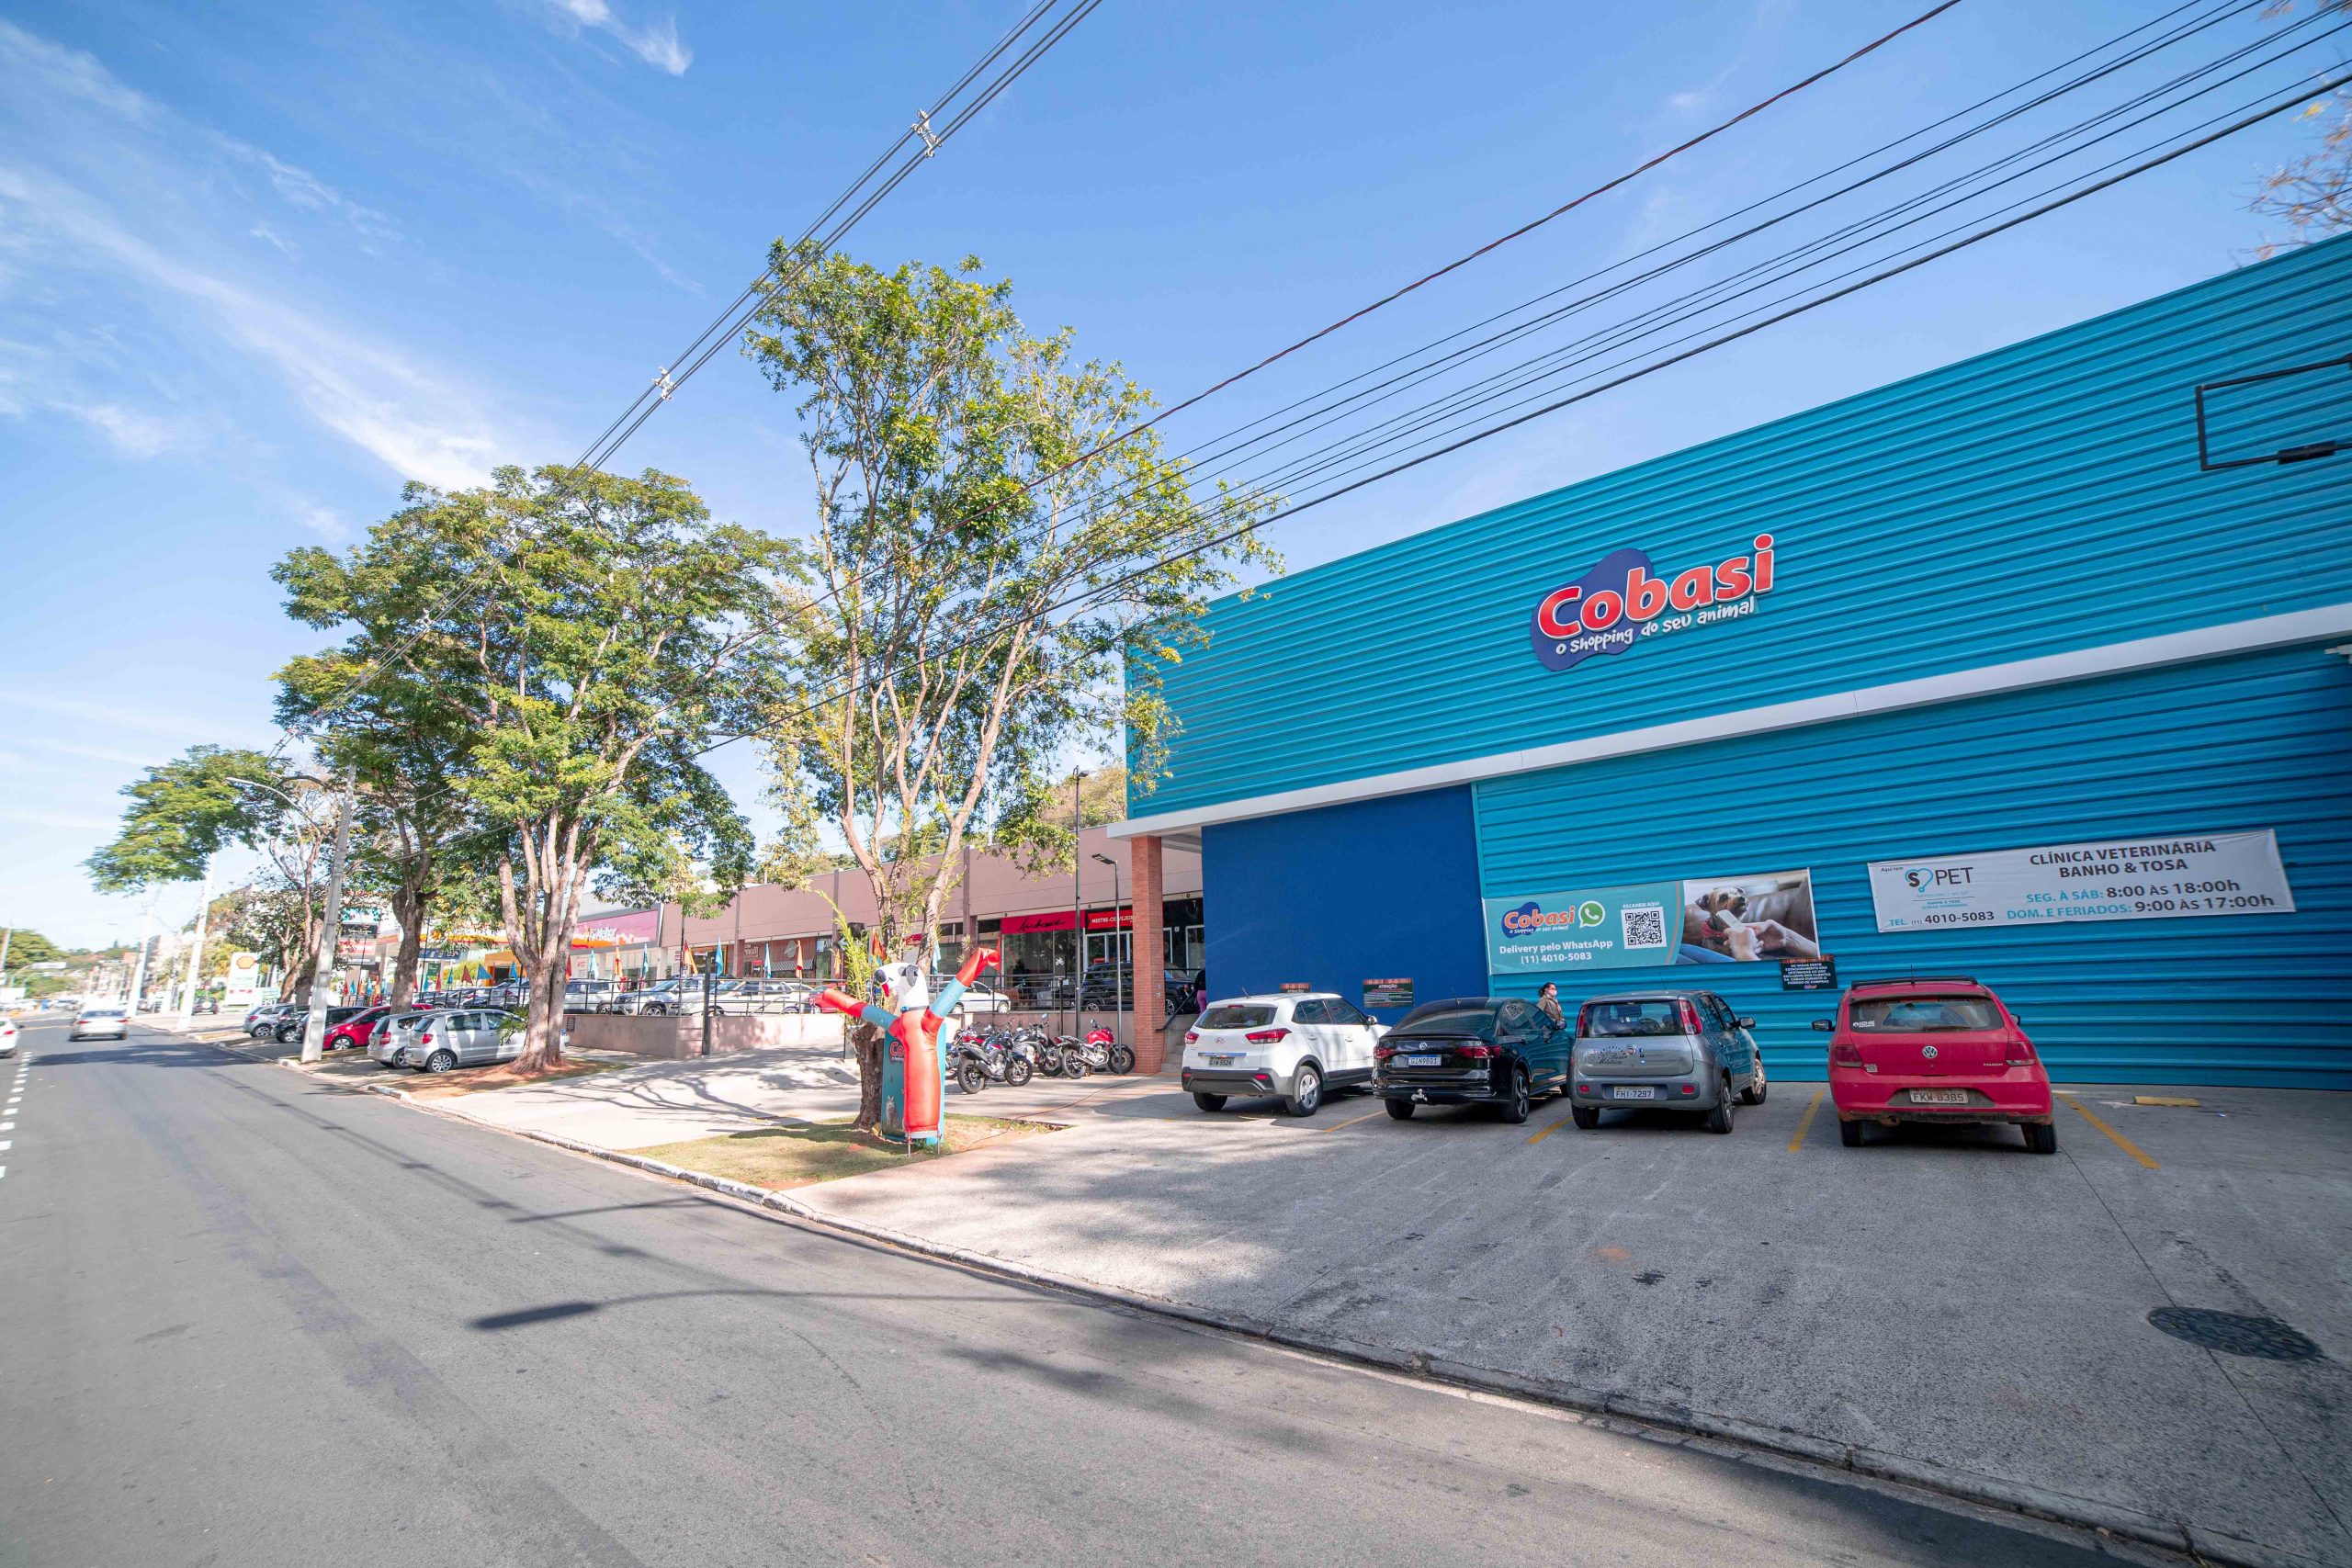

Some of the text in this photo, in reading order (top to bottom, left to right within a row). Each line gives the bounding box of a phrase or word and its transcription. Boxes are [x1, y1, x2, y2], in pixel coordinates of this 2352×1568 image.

[1537, 534, 1775, 640] Cobasi
[1555, 642, 1566, 656] o
[1640, 620, 1659, 637] do
[1662, 614, 1692, 633] seu
[1696, 596, 1756, 625] animal
[2030, 840, 2216, 865] CLÍNICA VETERINÁRIA
[2059, 858, 2188, 878] BANHO & TOSA
[2026, 879, 2240, 903] SEG. À SÁB: 8:00 ÀS 18:00h
[1504, 905, 1576, 929] Cobasi
[1925, 911, 1995, 924] 4010-5083
[2007, 894, 2275, 919] DOM. E FERIADOS: 9:00 ÀS 17:00h
[1499, 939, 1613, 954] Delivery pelo WhatsApp
[1521, 952, 1592, 965] (11) 4010-5083
